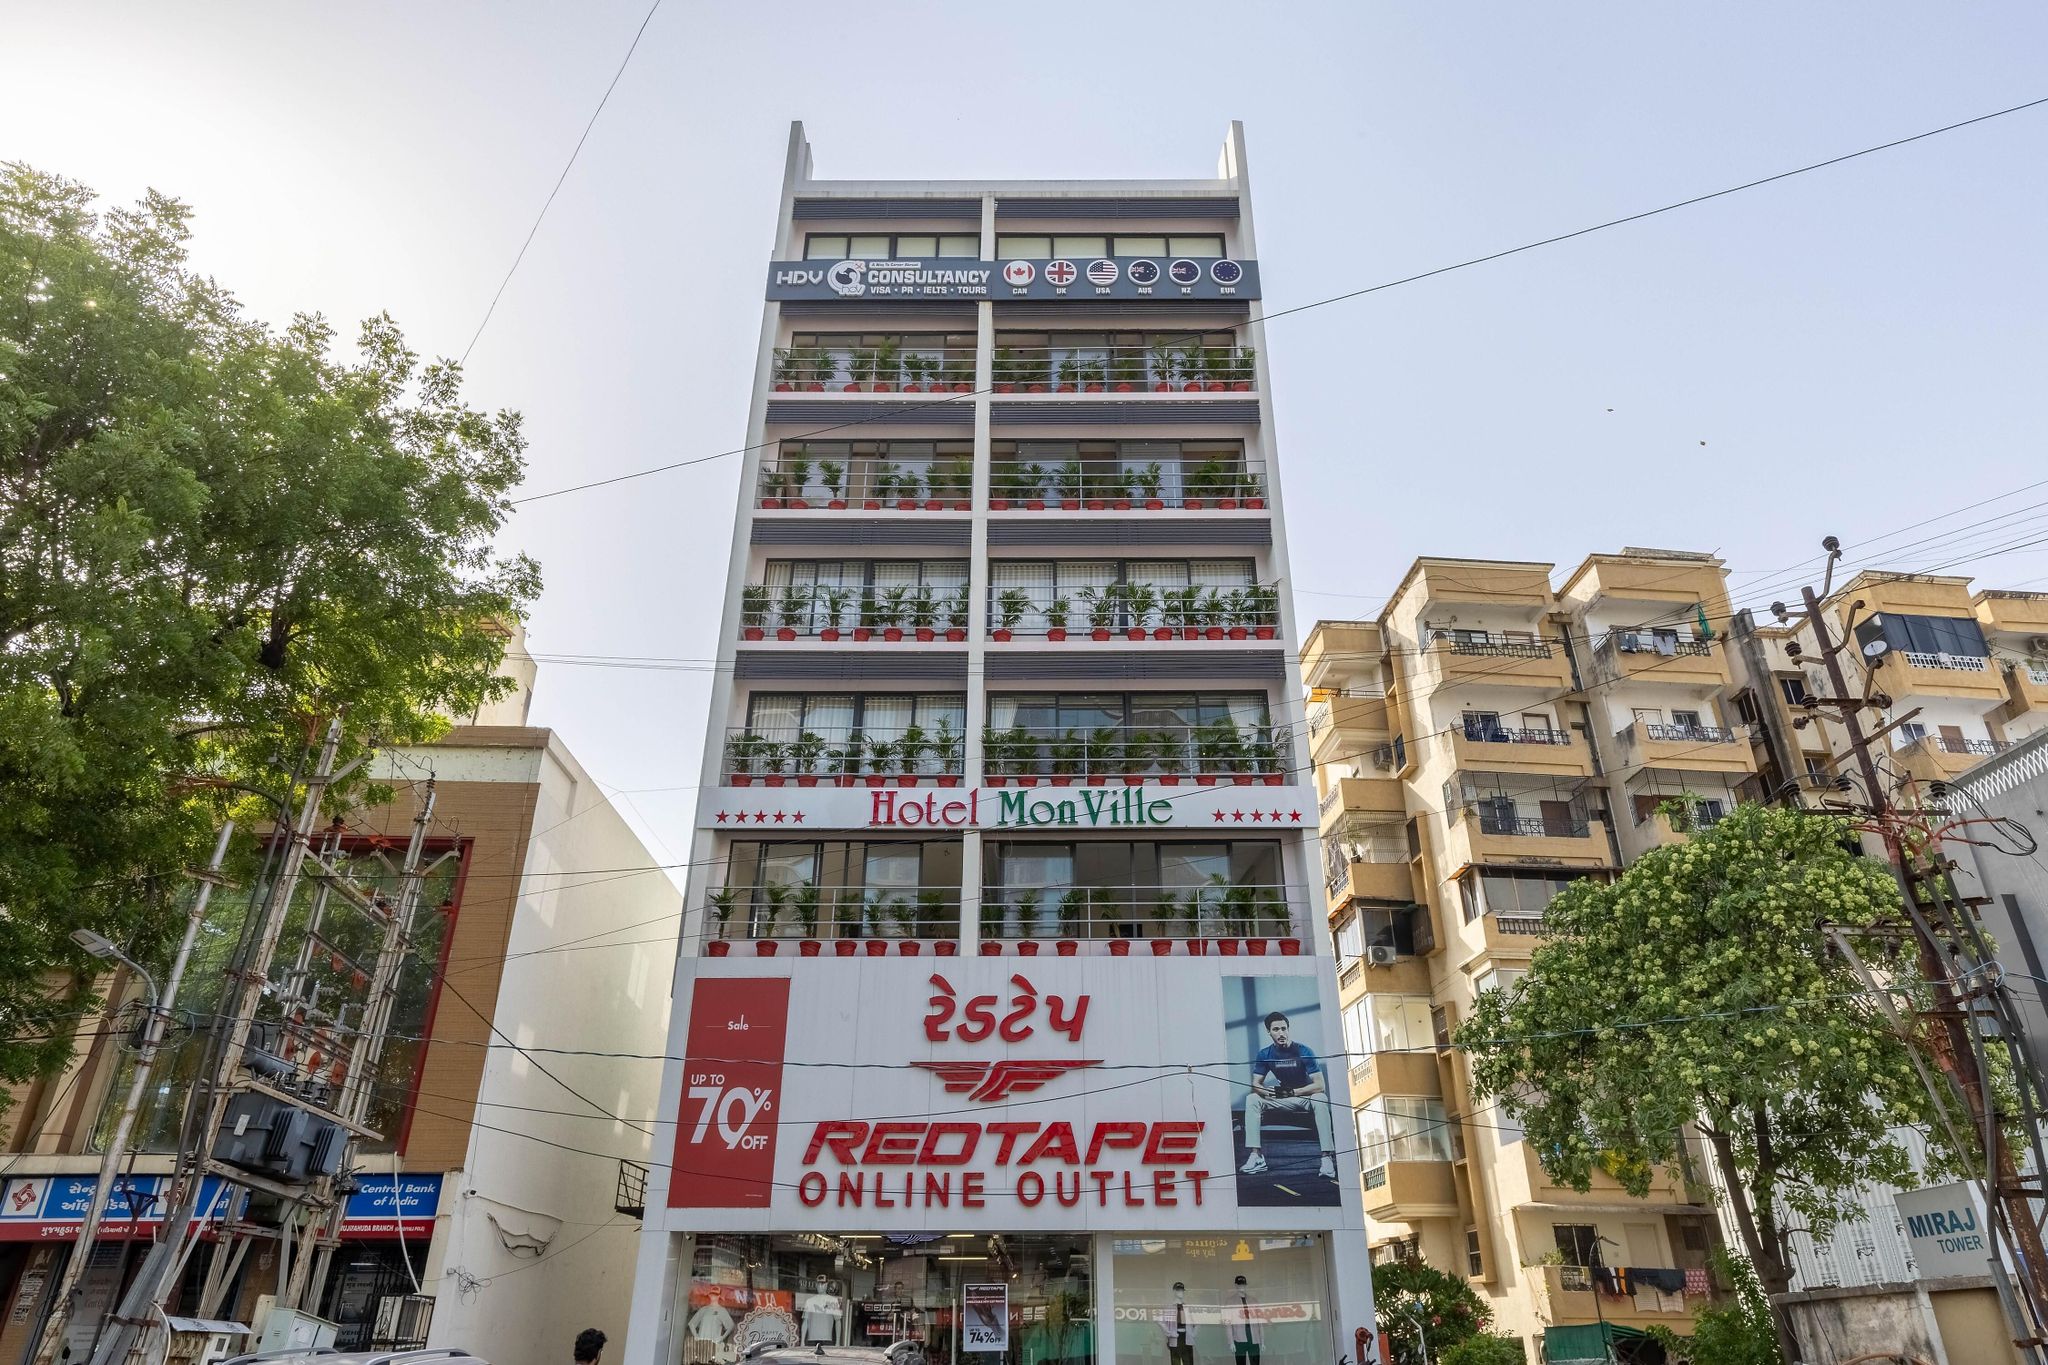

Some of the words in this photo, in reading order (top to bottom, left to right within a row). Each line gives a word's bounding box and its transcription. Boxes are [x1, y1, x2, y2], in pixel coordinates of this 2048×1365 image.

[776, 270, 824, 285] HDV
[868, 270, 991, 284] CONSULTANCY
[870, 286, 891, 294] VISA
[901, 286, 914, 294] PR
[923, 286, 948, 294] IELTS
[957, 286, 987, 294] TOURS
[1012, 287, 1028, 295] CAN
[1056, 287, 1067, 295] UK
[1095, 287, 1111, 295] USA
[1138, 287, 1153, 295] AUS
[1181, 287, 1191, 295] NZ
[1220, 287, 1236, 295] EUR
[869, 787, 979, 827] Hotel
[997, 786, 1174, 826] MonVille
[923, 973, 1091, 1042] રેડટેપ
[727, 1014, 749, 1031] Sale
[691, 1074, 707, 1085] UP
[710, 1074, 725, 1085] TO
[688, 1086, 773, 1150] 70%
[741, 1135, 769, 1150] OFF
[802, 1121, 1206, 1165] REDTAPE
[361, 1183, 403, 1194] Central
[405, 1184, 436, 1193] Bank
[799, 1170, 986, 1208] ONLINE
[1016, 1170, 1210, 1208] OUTLET
[373, 1196, 387, 1206] of
[1907, 1207, 1976, 1239] MIRAJ
[1936, 1235, 1985, 1254] TOWER
[969, 1332, 995, 1343] 74%
